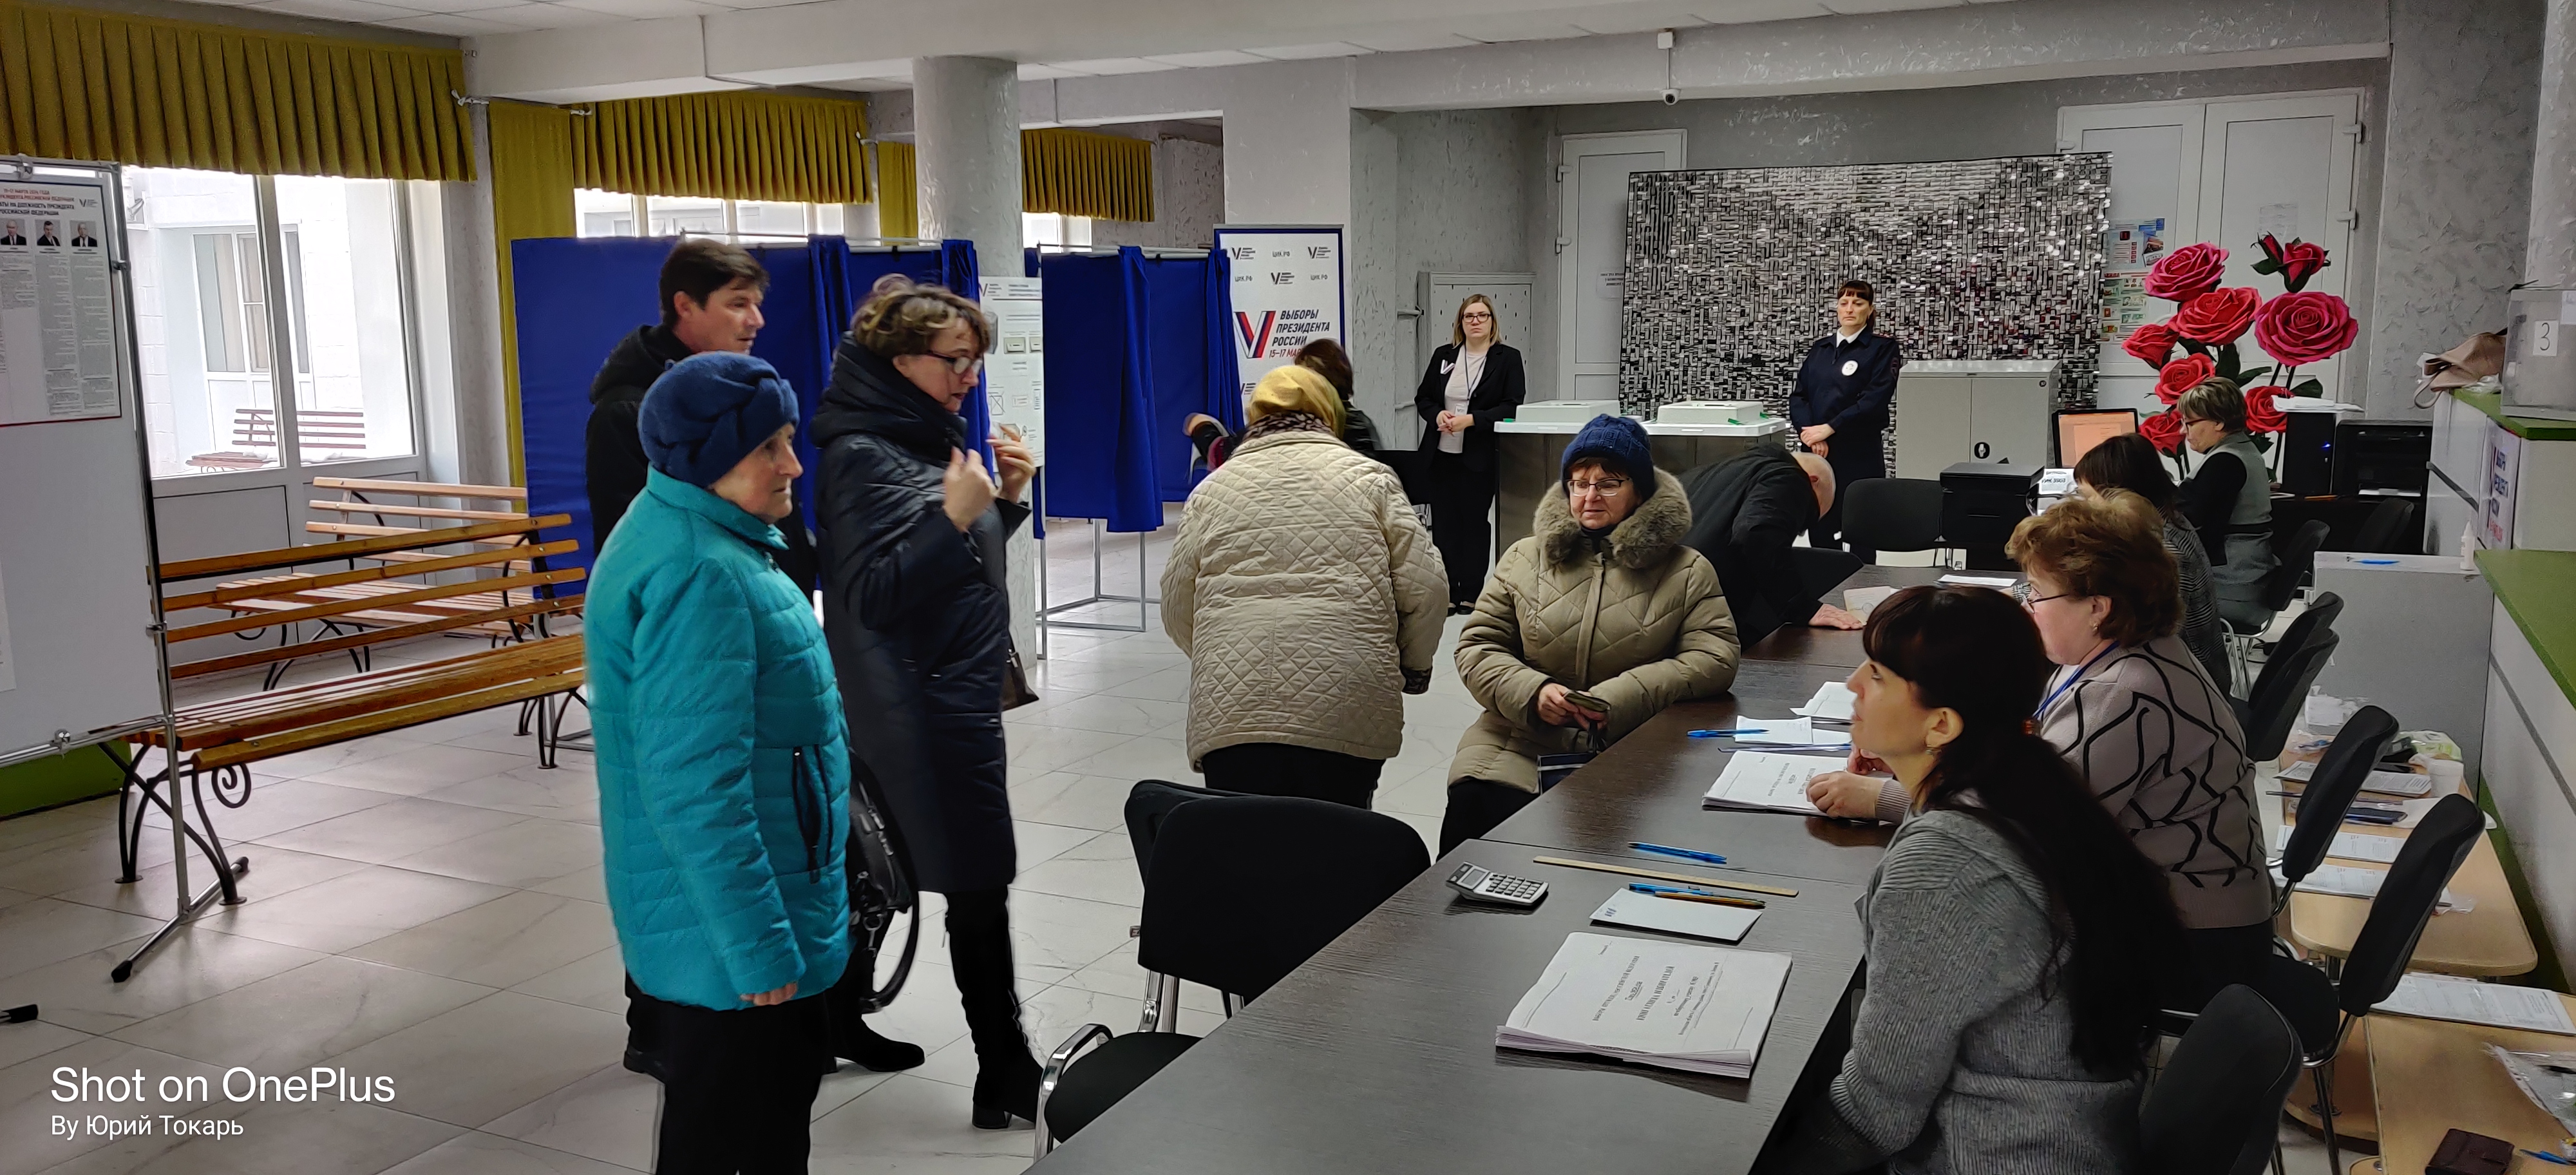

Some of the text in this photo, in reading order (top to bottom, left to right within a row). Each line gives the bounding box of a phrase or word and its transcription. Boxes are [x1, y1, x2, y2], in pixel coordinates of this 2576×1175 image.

[1280, 309, 1319, 320] ВЫБОРЫ
[1276, 321, 1331, 334] ПРЕЗИДЕНТА
[1271, 336, 1307, 347] РОССИИ
[2539, 322, 2550, 350] 3
[1286, 348, 1302, 357] МАР
